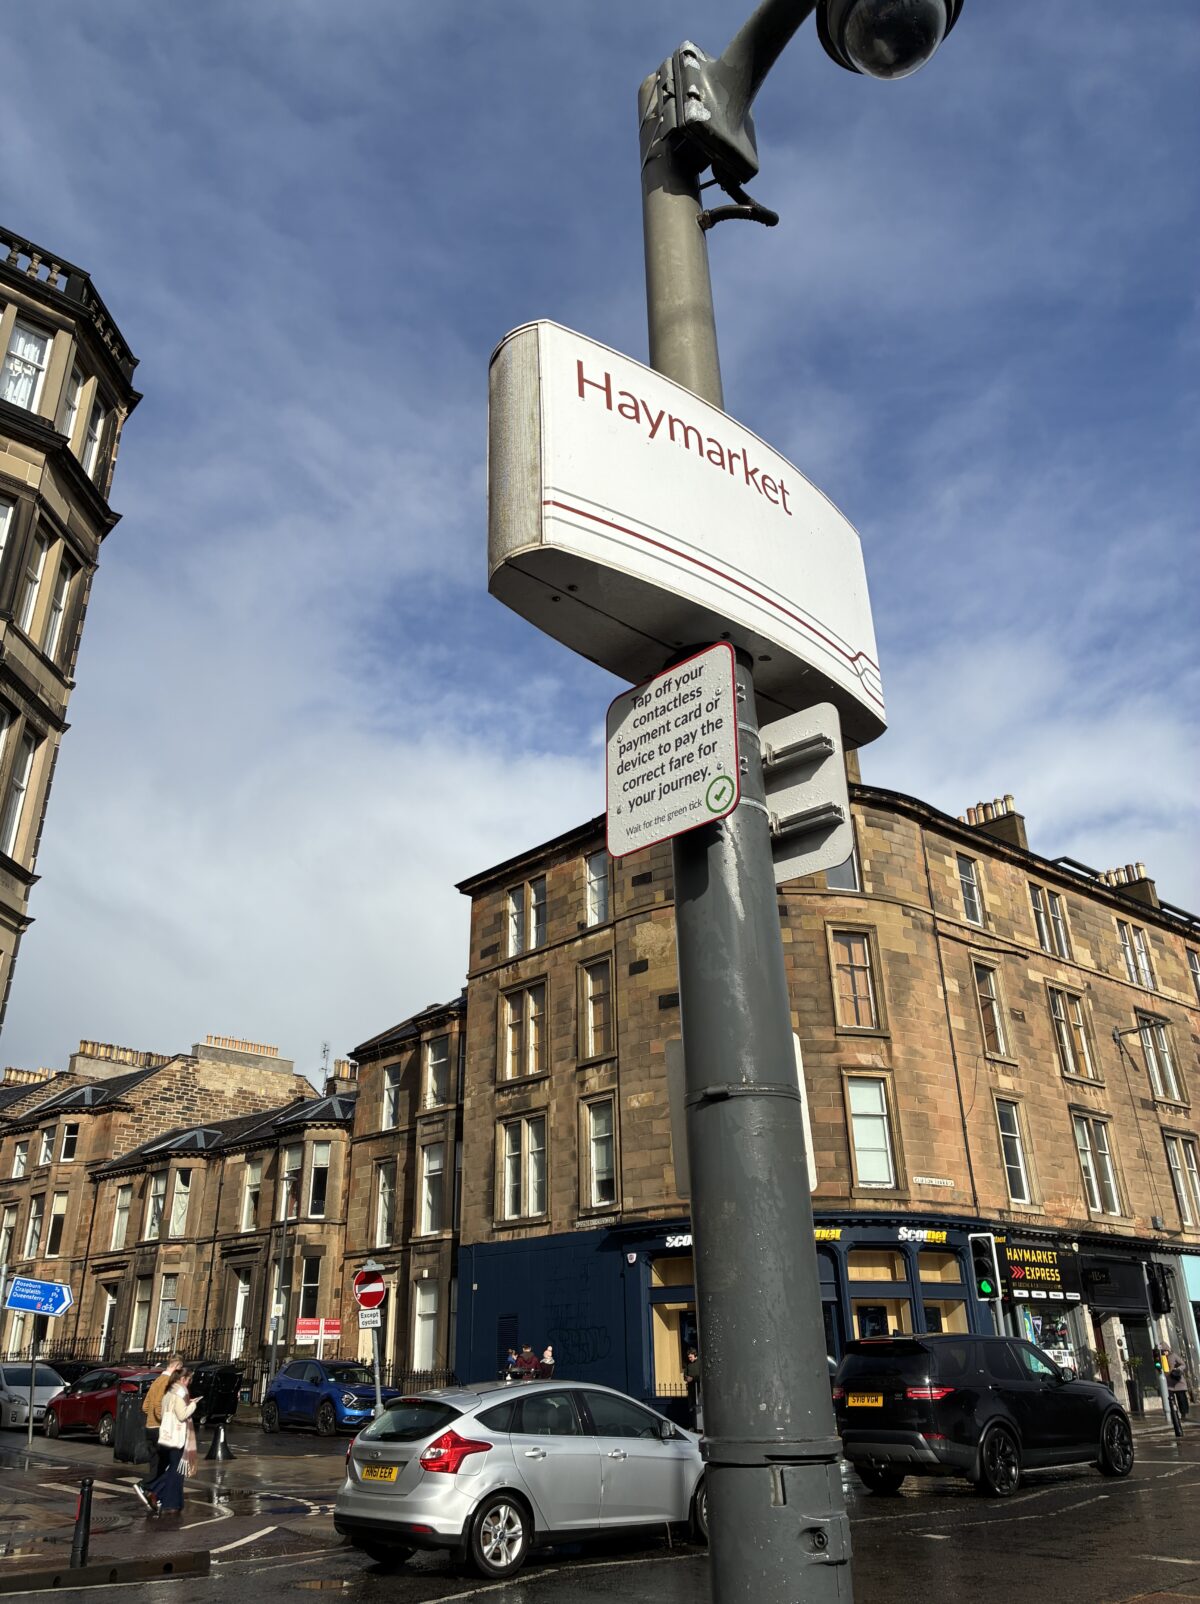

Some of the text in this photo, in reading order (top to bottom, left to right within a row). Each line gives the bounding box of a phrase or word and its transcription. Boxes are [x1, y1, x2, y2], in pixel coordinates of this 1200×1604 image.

[576, 359, 793, 517] Haymarket
[631, 664, 705, 711] Tap off your
[632, 686, 703, 729] contactless
[616, 717, 724, 776] device to pay the
[618, 697, 721, 758] payment card or
[622, 740, 718, 793] correct fare for
[628, 765, 712, 813] your journey.
[625, 798, 704, 838] Wait for the green tick
[1006, 1247, 1058, 1264] HAYMARKET
[1025, 1266, 1061, 1282] EXPRESS
[12, 1292, 45, 1302] Queensferry
